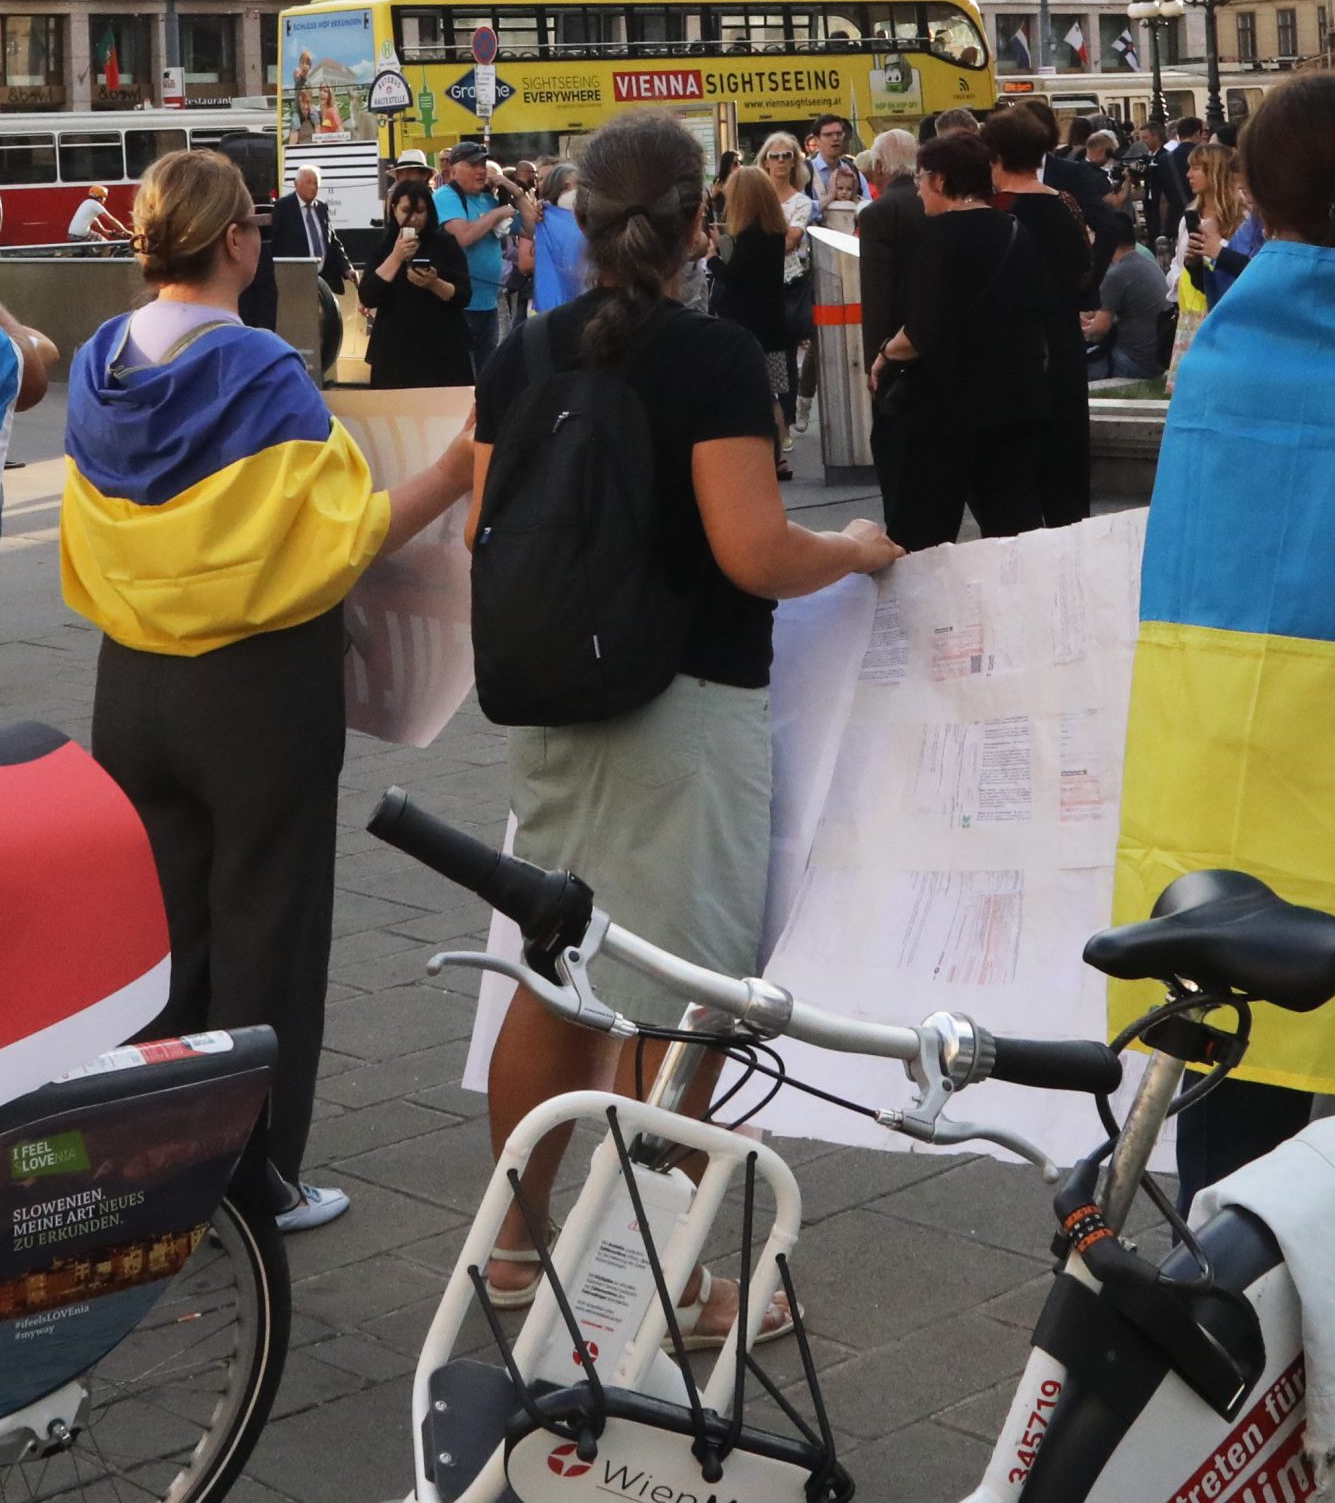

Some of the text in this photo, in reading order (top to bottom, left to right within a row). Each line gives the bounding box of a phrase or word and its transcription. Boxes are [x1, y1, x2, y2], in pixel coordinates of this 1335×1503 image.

[318, 20, 329, 28] HOF
[522, 75, 600, 91] SIGHTSEEING
[616, 70, 840, 98] VIENNA SIGHTSEEING
[524, 90, 601, 104] EVERYWHERE
[744, 97, 842, 109] www.viennasightseeing.at
[22, 1141, 52, 1158] FEEL
[13, 1188, 106, 1223] SLOWENIEN.
[14, 1190, 145, 1237] MEINE ART NEUES
[14, 1212, 124, 1251] ZU ERKUNDEN.
[15, 1325, 56, 1340] #myway
[1008, 1379, 1062, 1488] 345719
